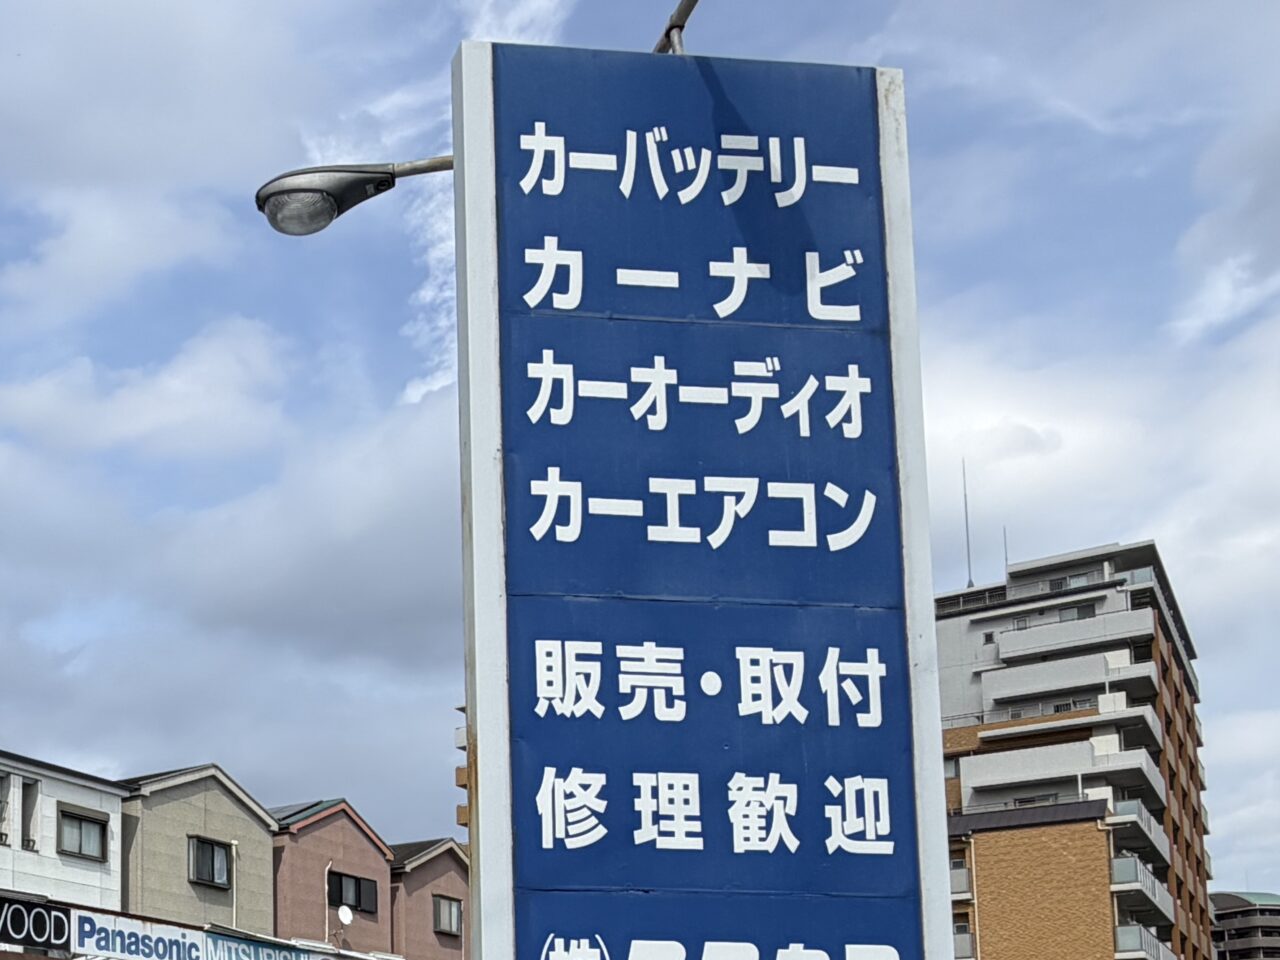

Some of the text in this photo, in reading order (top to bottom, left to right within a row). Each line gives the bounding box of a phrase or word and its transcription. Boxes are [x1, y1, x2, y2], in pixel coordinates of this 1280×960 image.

[519, 121, 859, 207] カーバッテリー
[522, 236, 863, 321] カーナビ
[526, 349, 871, 439] カーオーディオ
[530, 467, 876, 551] カーエアコン
[534, 640, 887, 728] 販売・取付
[536, 767, 894, 854] 修理歓迎
